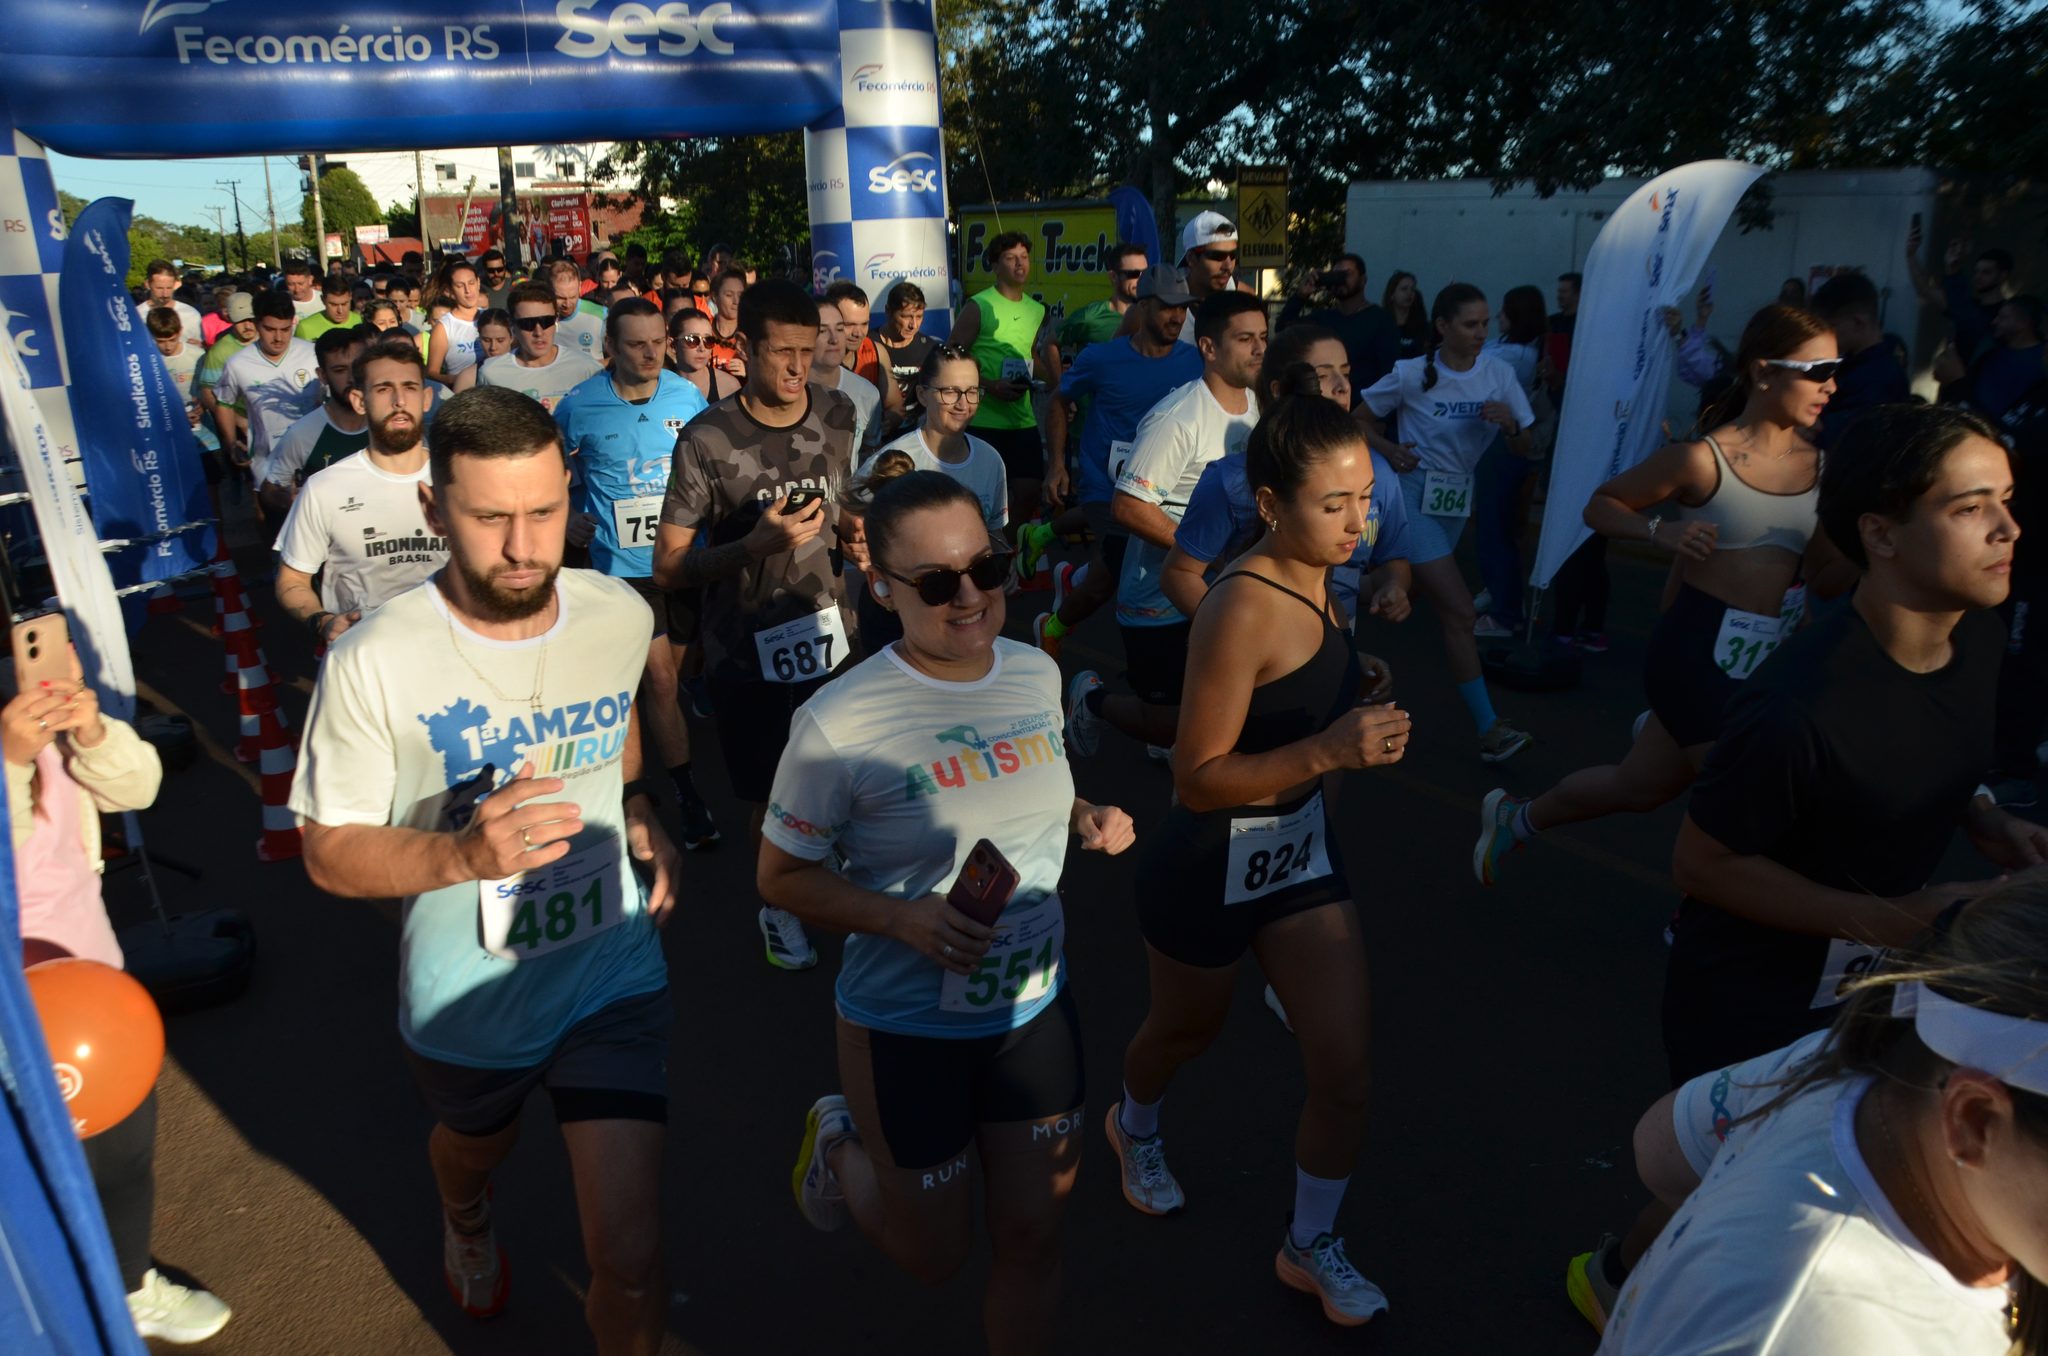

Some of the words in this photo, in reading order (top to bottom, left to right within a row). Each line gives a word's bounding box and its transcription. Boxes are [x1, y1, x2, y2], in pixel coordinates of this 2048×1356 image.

[173, 24, 432, 64] Fecomércio
[445, 25, 499, 61] RS
[555, 1, 734, 58] Sesc
[858, 81, 925, 92] Fecomércio
[830, 178, 844, 190] RS
[868, 164, 937, 193] Sesc
[4, 219, 26, 233] RS
[1242, 244, 1285, 256] ELEVADA
[871, 267, 936, 280] Fecomércio
[937, 266, 947, 278] RS
[114, 295, 132, 333] Sesc
[128, 353, 152, 429] Sindicatos
[158, 397, 173, 432] Sistema
[145, 450, 158, 471] RS
[151, 474, 173, 557] Feomércio
[1430, 487, 1467, 513] 364
[389, 554, 432, 565] BRASIL
[773, 634, 834, 681] 687
[506, 690, 631, 747] AMZOP
[906, 730, 1065, 800] Autismo
[1244, 832, 1313, 891] 824
[497, 878, 547, 898] Sesc
[506, 877, 602, 950] 481
[992, 934, 1013, 949] sc
[965, 935, 1053, 1007] 551
[922, 1154, 968, 1190] RUN
